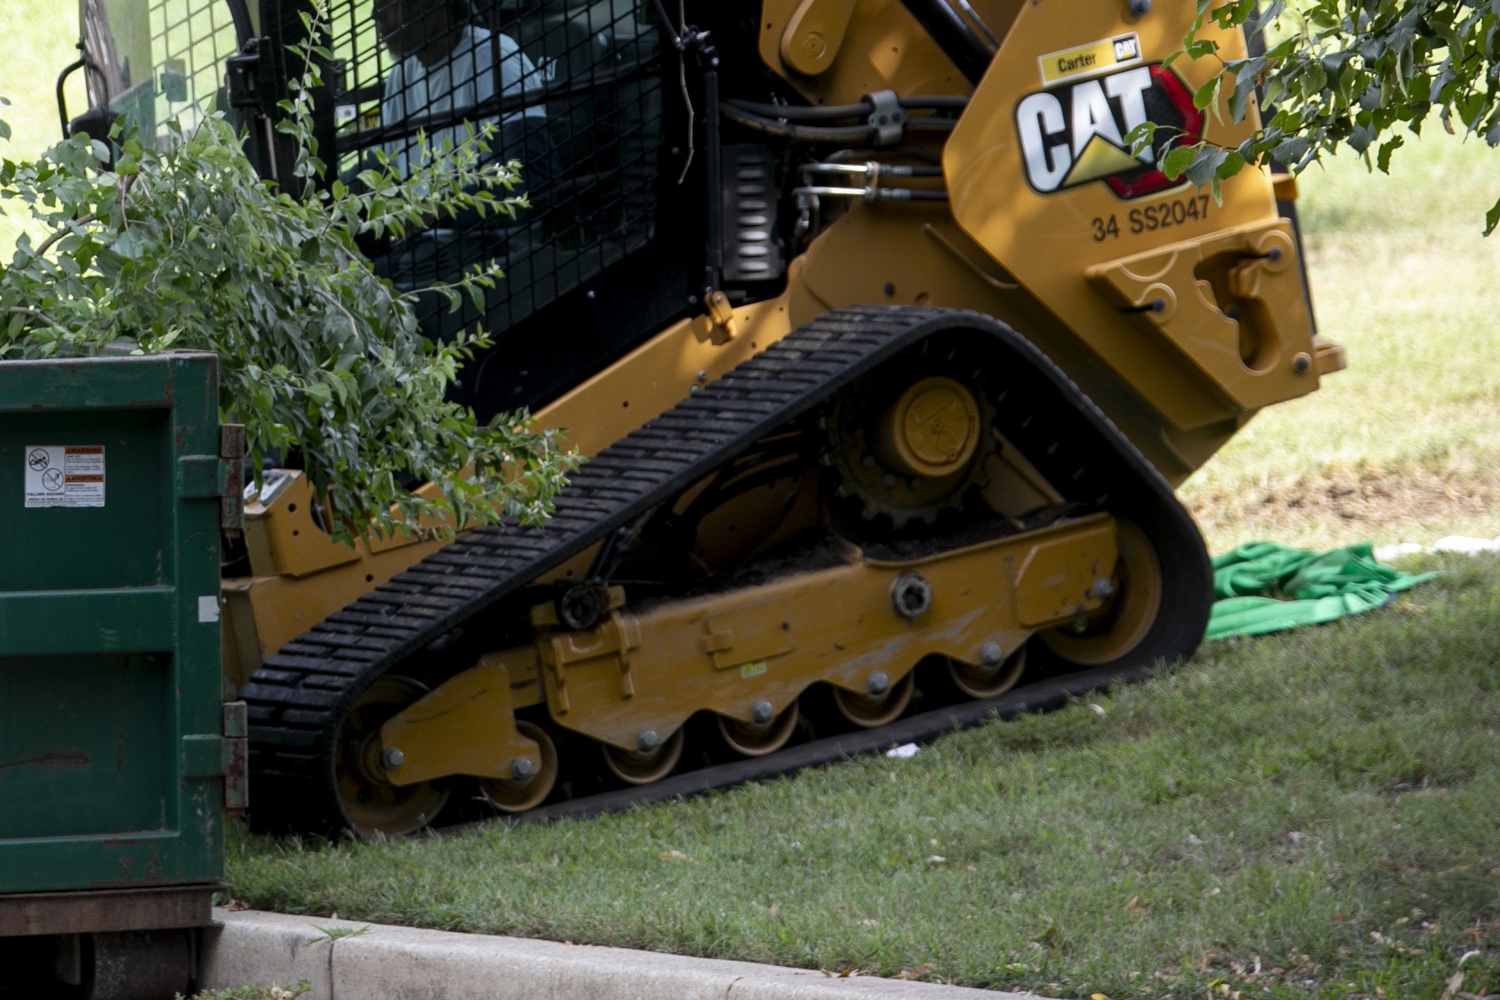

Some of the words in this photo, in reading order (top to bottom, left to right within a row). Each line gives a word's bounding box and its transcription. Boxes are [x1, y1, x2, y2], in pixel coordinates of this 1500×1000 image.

[1057, 53, 1097, 73] Carter
[1114, 38, 1138, 60] CAT
[1016, 66, 1155, 192] CAT
[1091, 214, 1120, 243] 34
[1128, 194, 1211, 235] SS2047
